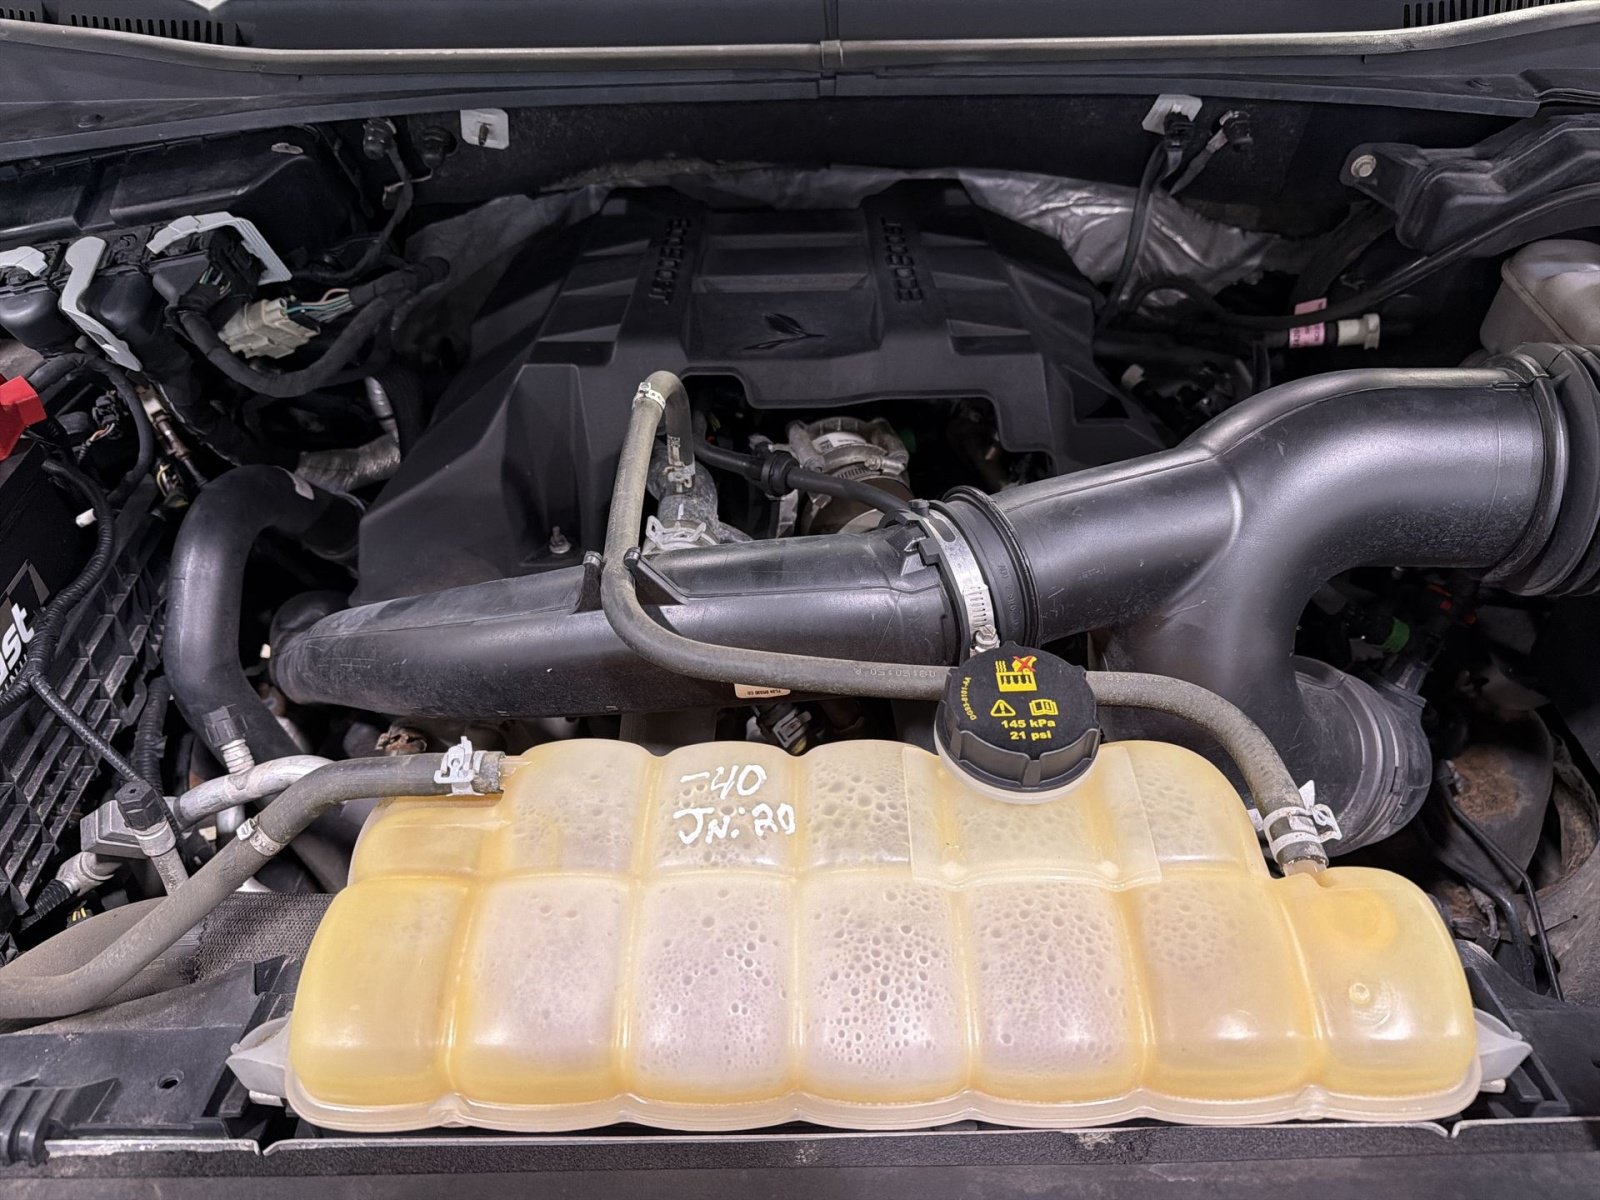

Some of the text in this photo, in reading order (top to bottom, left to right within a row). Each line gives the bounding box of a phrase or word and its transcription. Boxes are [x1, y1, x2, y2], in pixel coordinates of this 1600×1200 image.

[1001, 719, 1056, 728] 145 kPa
[1010, 730, 1052, 741] 21 psi
[680, 764, 767, 799] -40
